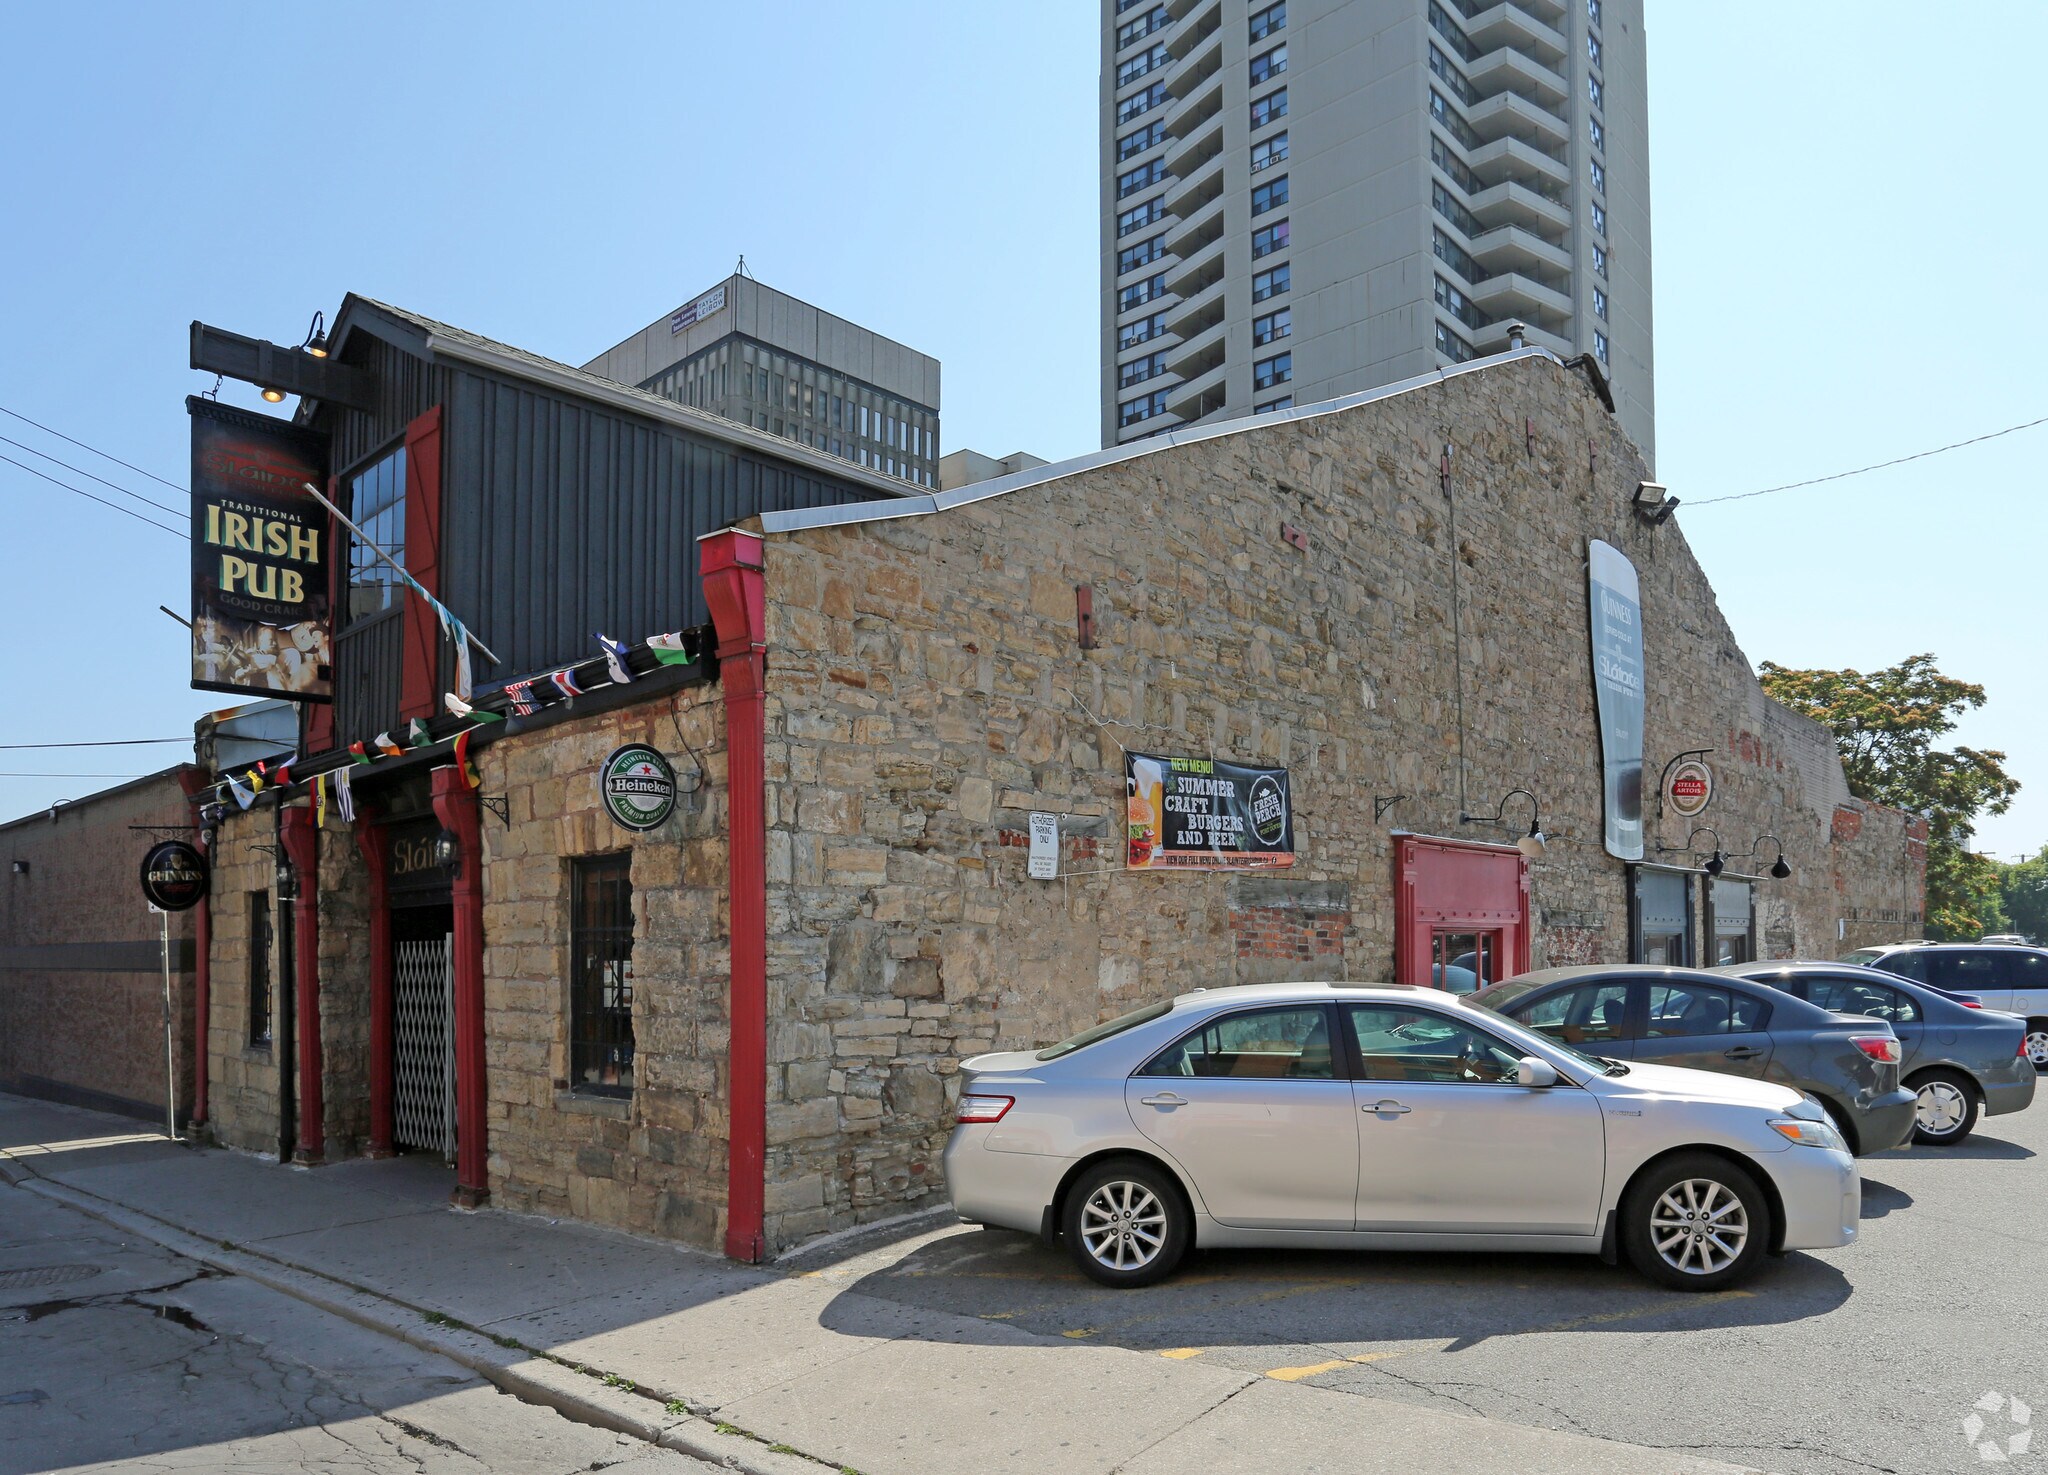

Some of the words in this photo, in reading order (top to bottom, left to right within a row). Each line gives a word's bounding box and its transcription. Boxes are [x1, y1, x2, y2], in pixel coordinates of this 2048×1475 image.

[698, 291, 724, 310] TAYLOR
[698, 298, 724, 317] LEIBOW
[221, 499, 302, 523] TRADITIONAL
[205, 504, 319, 564] IRISH
[220, 554, 305, 604] PUB
[219, 594, 261, 611] GOOD
[1600, 590, 1631, 625] GUINNESS
[620, 754, 651, 769] HEINEKEN
[1171, 758, 1189, 771] NEW
[1189, 759, 1213, 774] MENU!
[615, 779, 671, 795] Heineken
[1177, 776, 1235, 797] SUMMER
[619, 800, 645, 820] PREMIUM
[645, 804, 667, 820] QUALITY
[1165, 795, 1209, 813] CRAFT
[1253, 794, 1279, 812] FRESH
[1255, 802, 1282, 824] PERCH
[1035, 826, 1052, 835] PARKING
[1187, 813, 1244, 832] BURGERS
[1039, 835, 1049, 843] ONLY
[1177, 830, 1203, 845] AND
[1208, 831, 1236, 846] BEER
[1166, 856, 1177, 865] VIEW
[1188, 856, 1200, 865] FULL
[1200, 856, 1212, 865] MENU
[148, 870, 203, 882] GUINNESS
